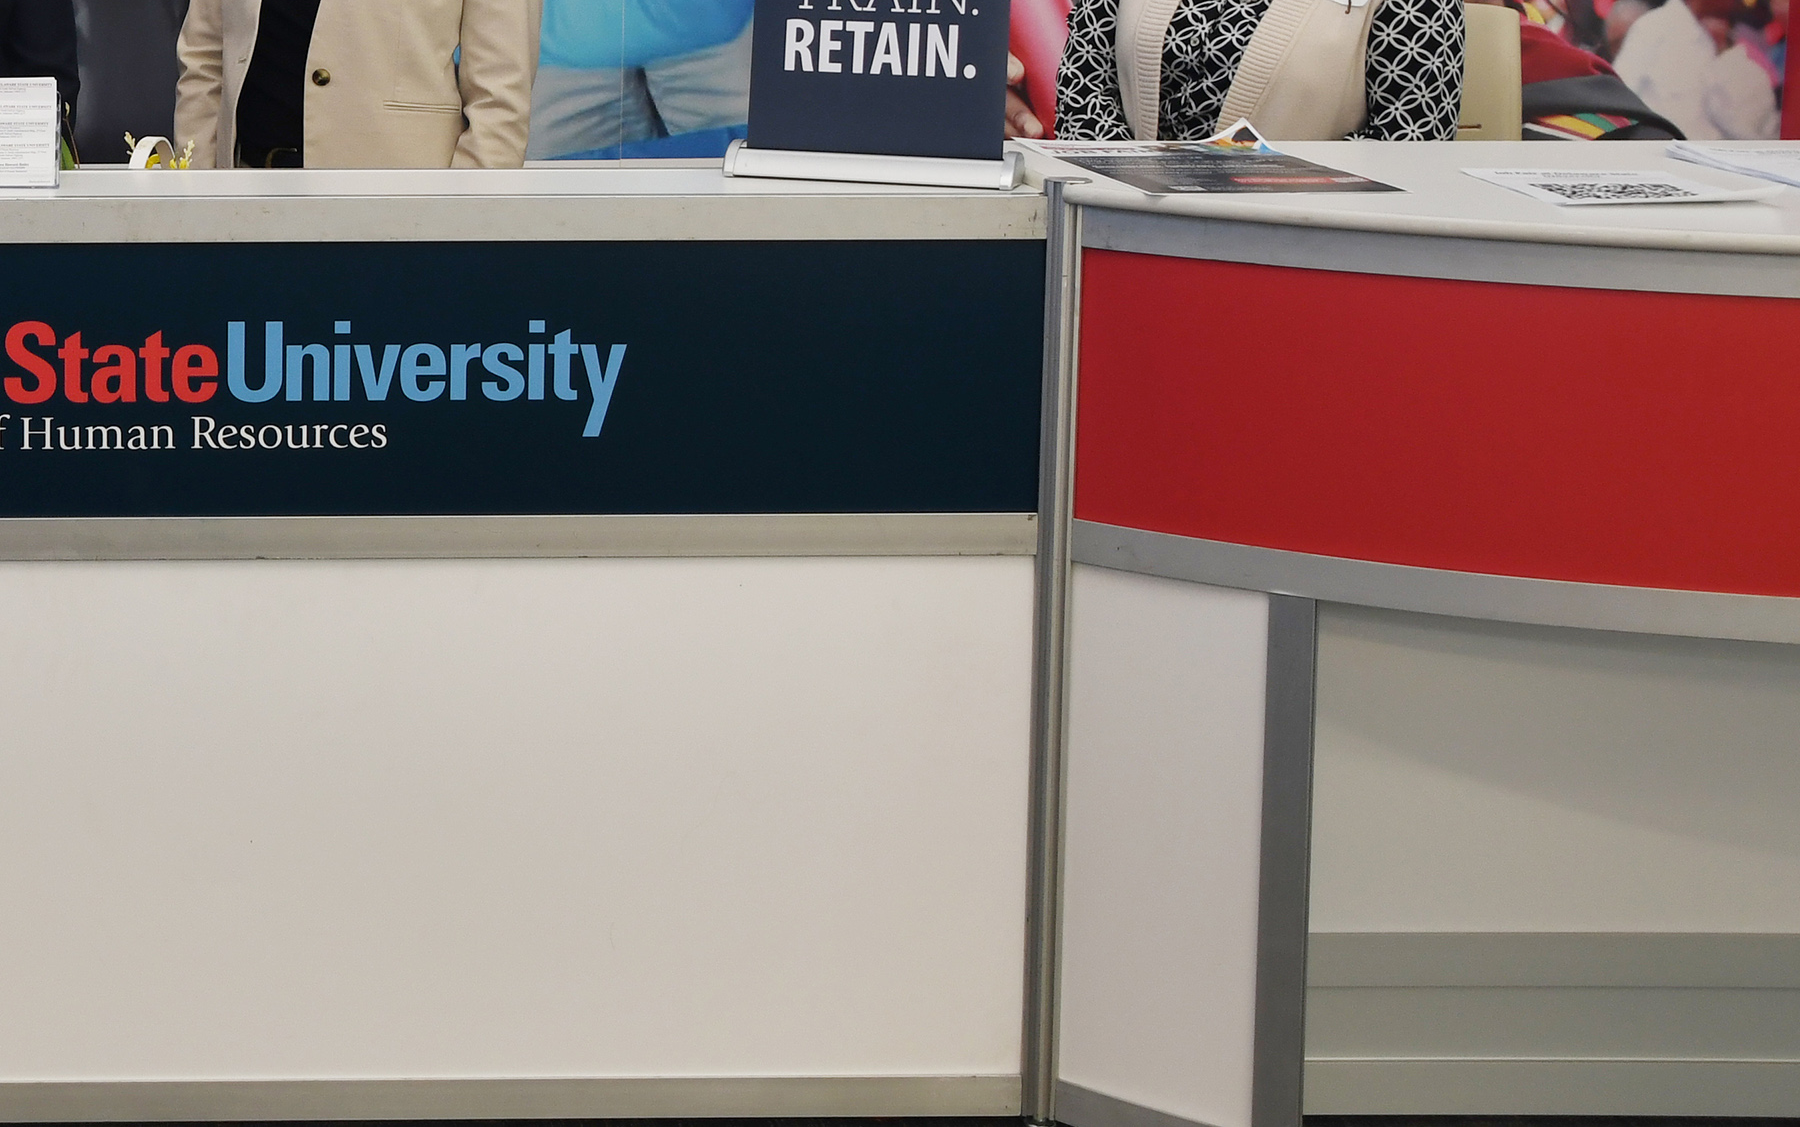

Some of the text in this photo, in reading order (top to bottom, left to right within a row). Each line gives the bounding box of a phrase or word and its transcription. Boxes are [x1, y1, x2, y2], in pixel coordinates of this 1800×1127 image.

[784, 18, 977, 79] RETAIN.
[3, 320, 218, 404] State
[227, 320, 627, 438] University
[21, 416, 175, 451] Human
[190, 416, 387, 450] Resources
